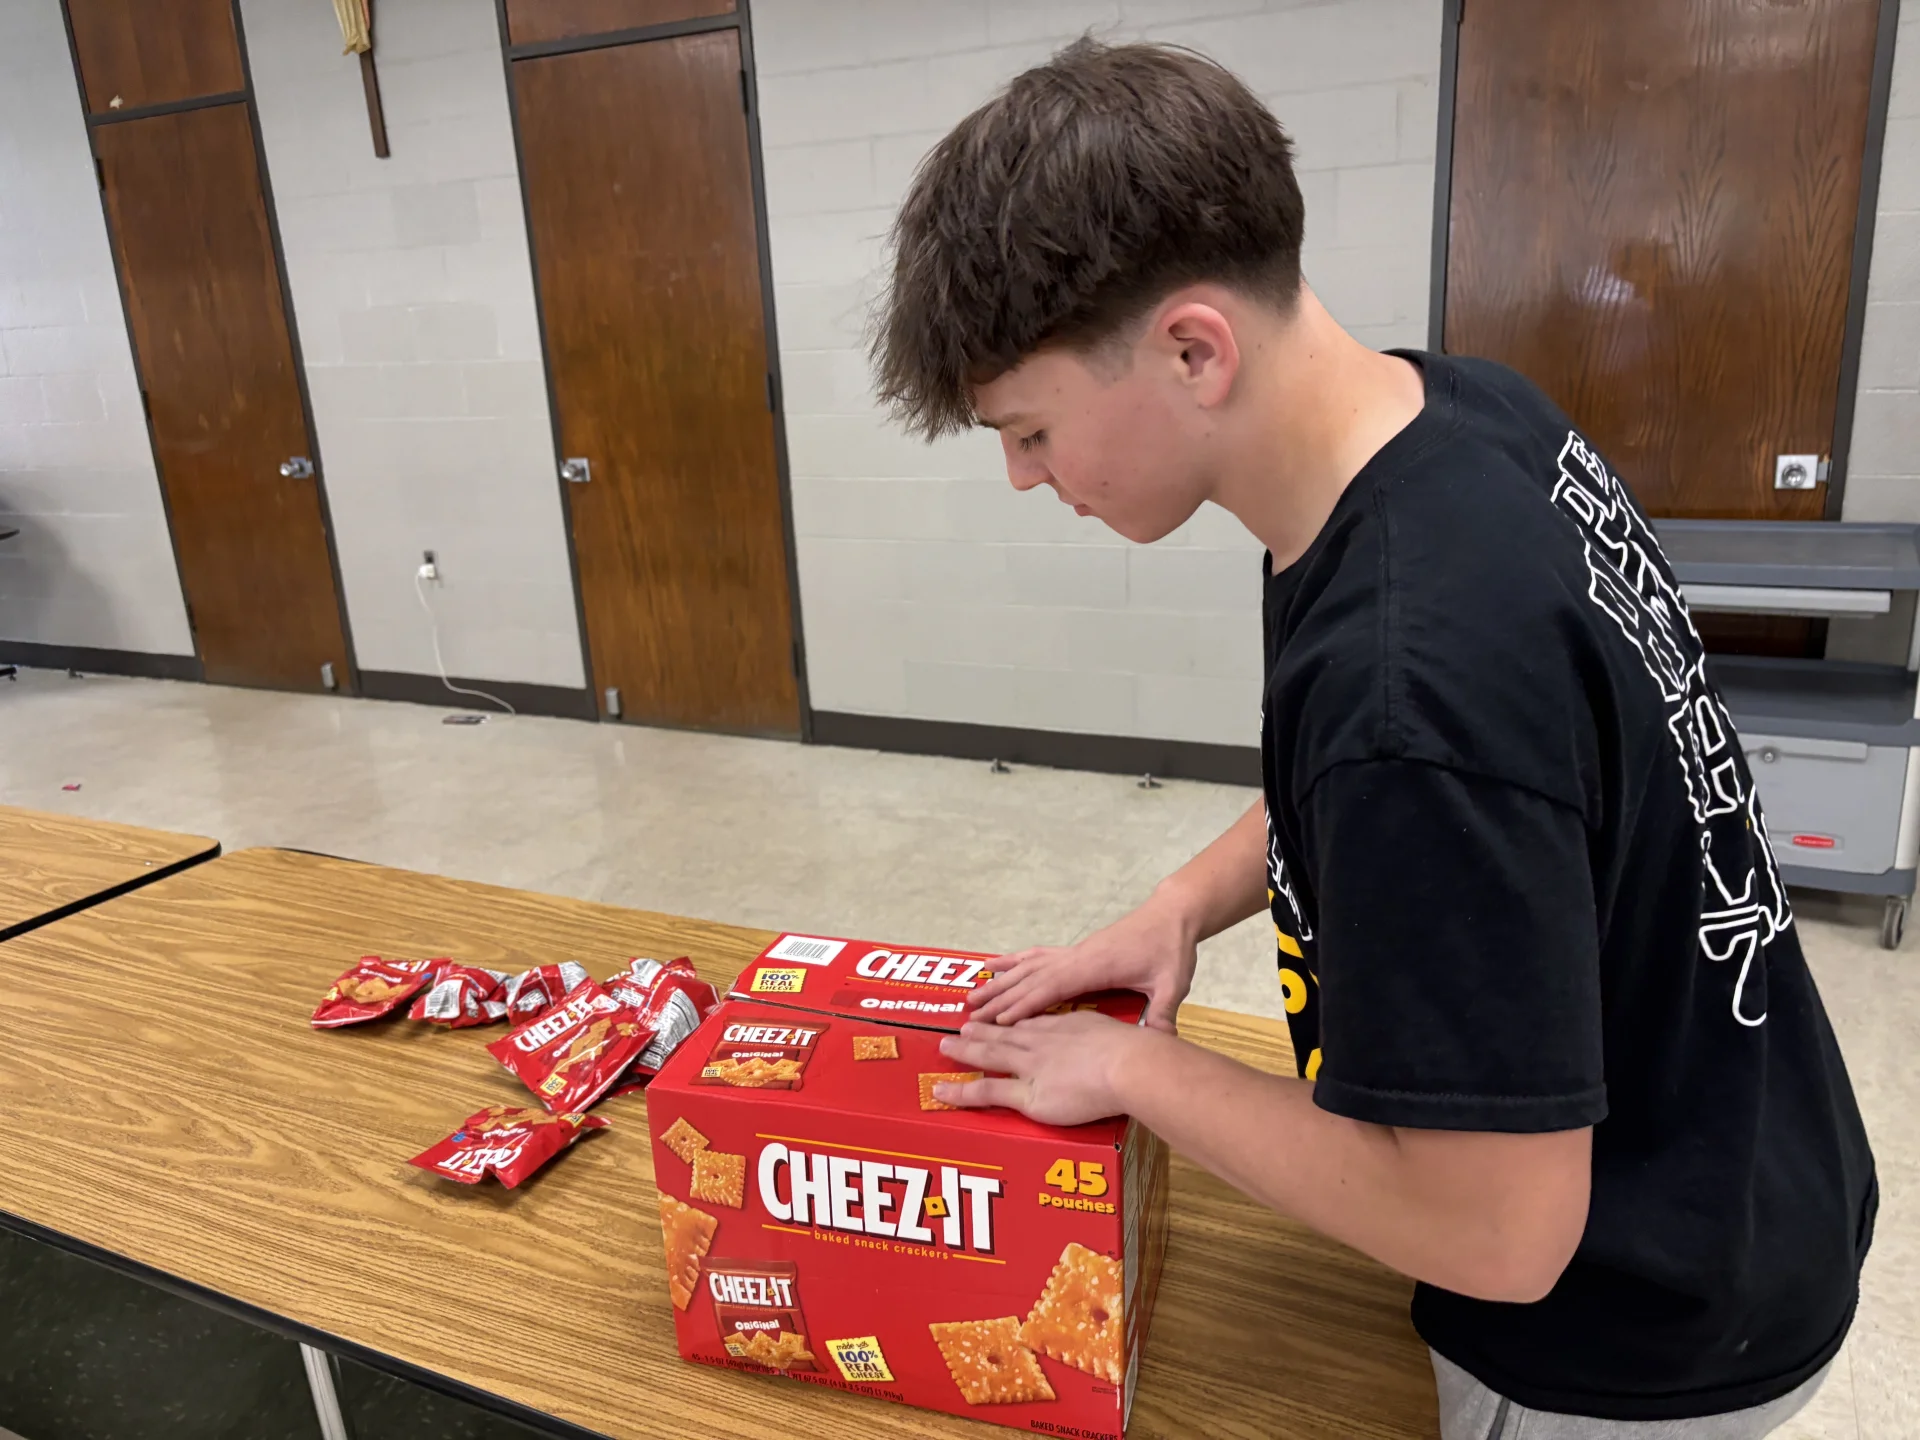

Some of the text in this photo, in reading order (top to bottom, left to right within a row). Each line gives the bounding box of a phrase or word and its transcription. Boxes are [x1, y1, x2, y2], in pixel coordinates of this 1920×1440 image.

[761, 973, 800, 981] 100%
[1045, 1158, 1108, 1197] 45
[1038, 1192, 1116, 1214] Pouches
[814, 1230, 949, 1260] baked snack crackers
[836, 1342, 855, 1351] made
[838, 1350, 879, 1363] 100%
[844, 1363, 882, 1372] REAL
[851, 1370, 886, 1379] CHEESE
[1030, 1419, 1119, 1440] BAKED SNACK CRACKERS
